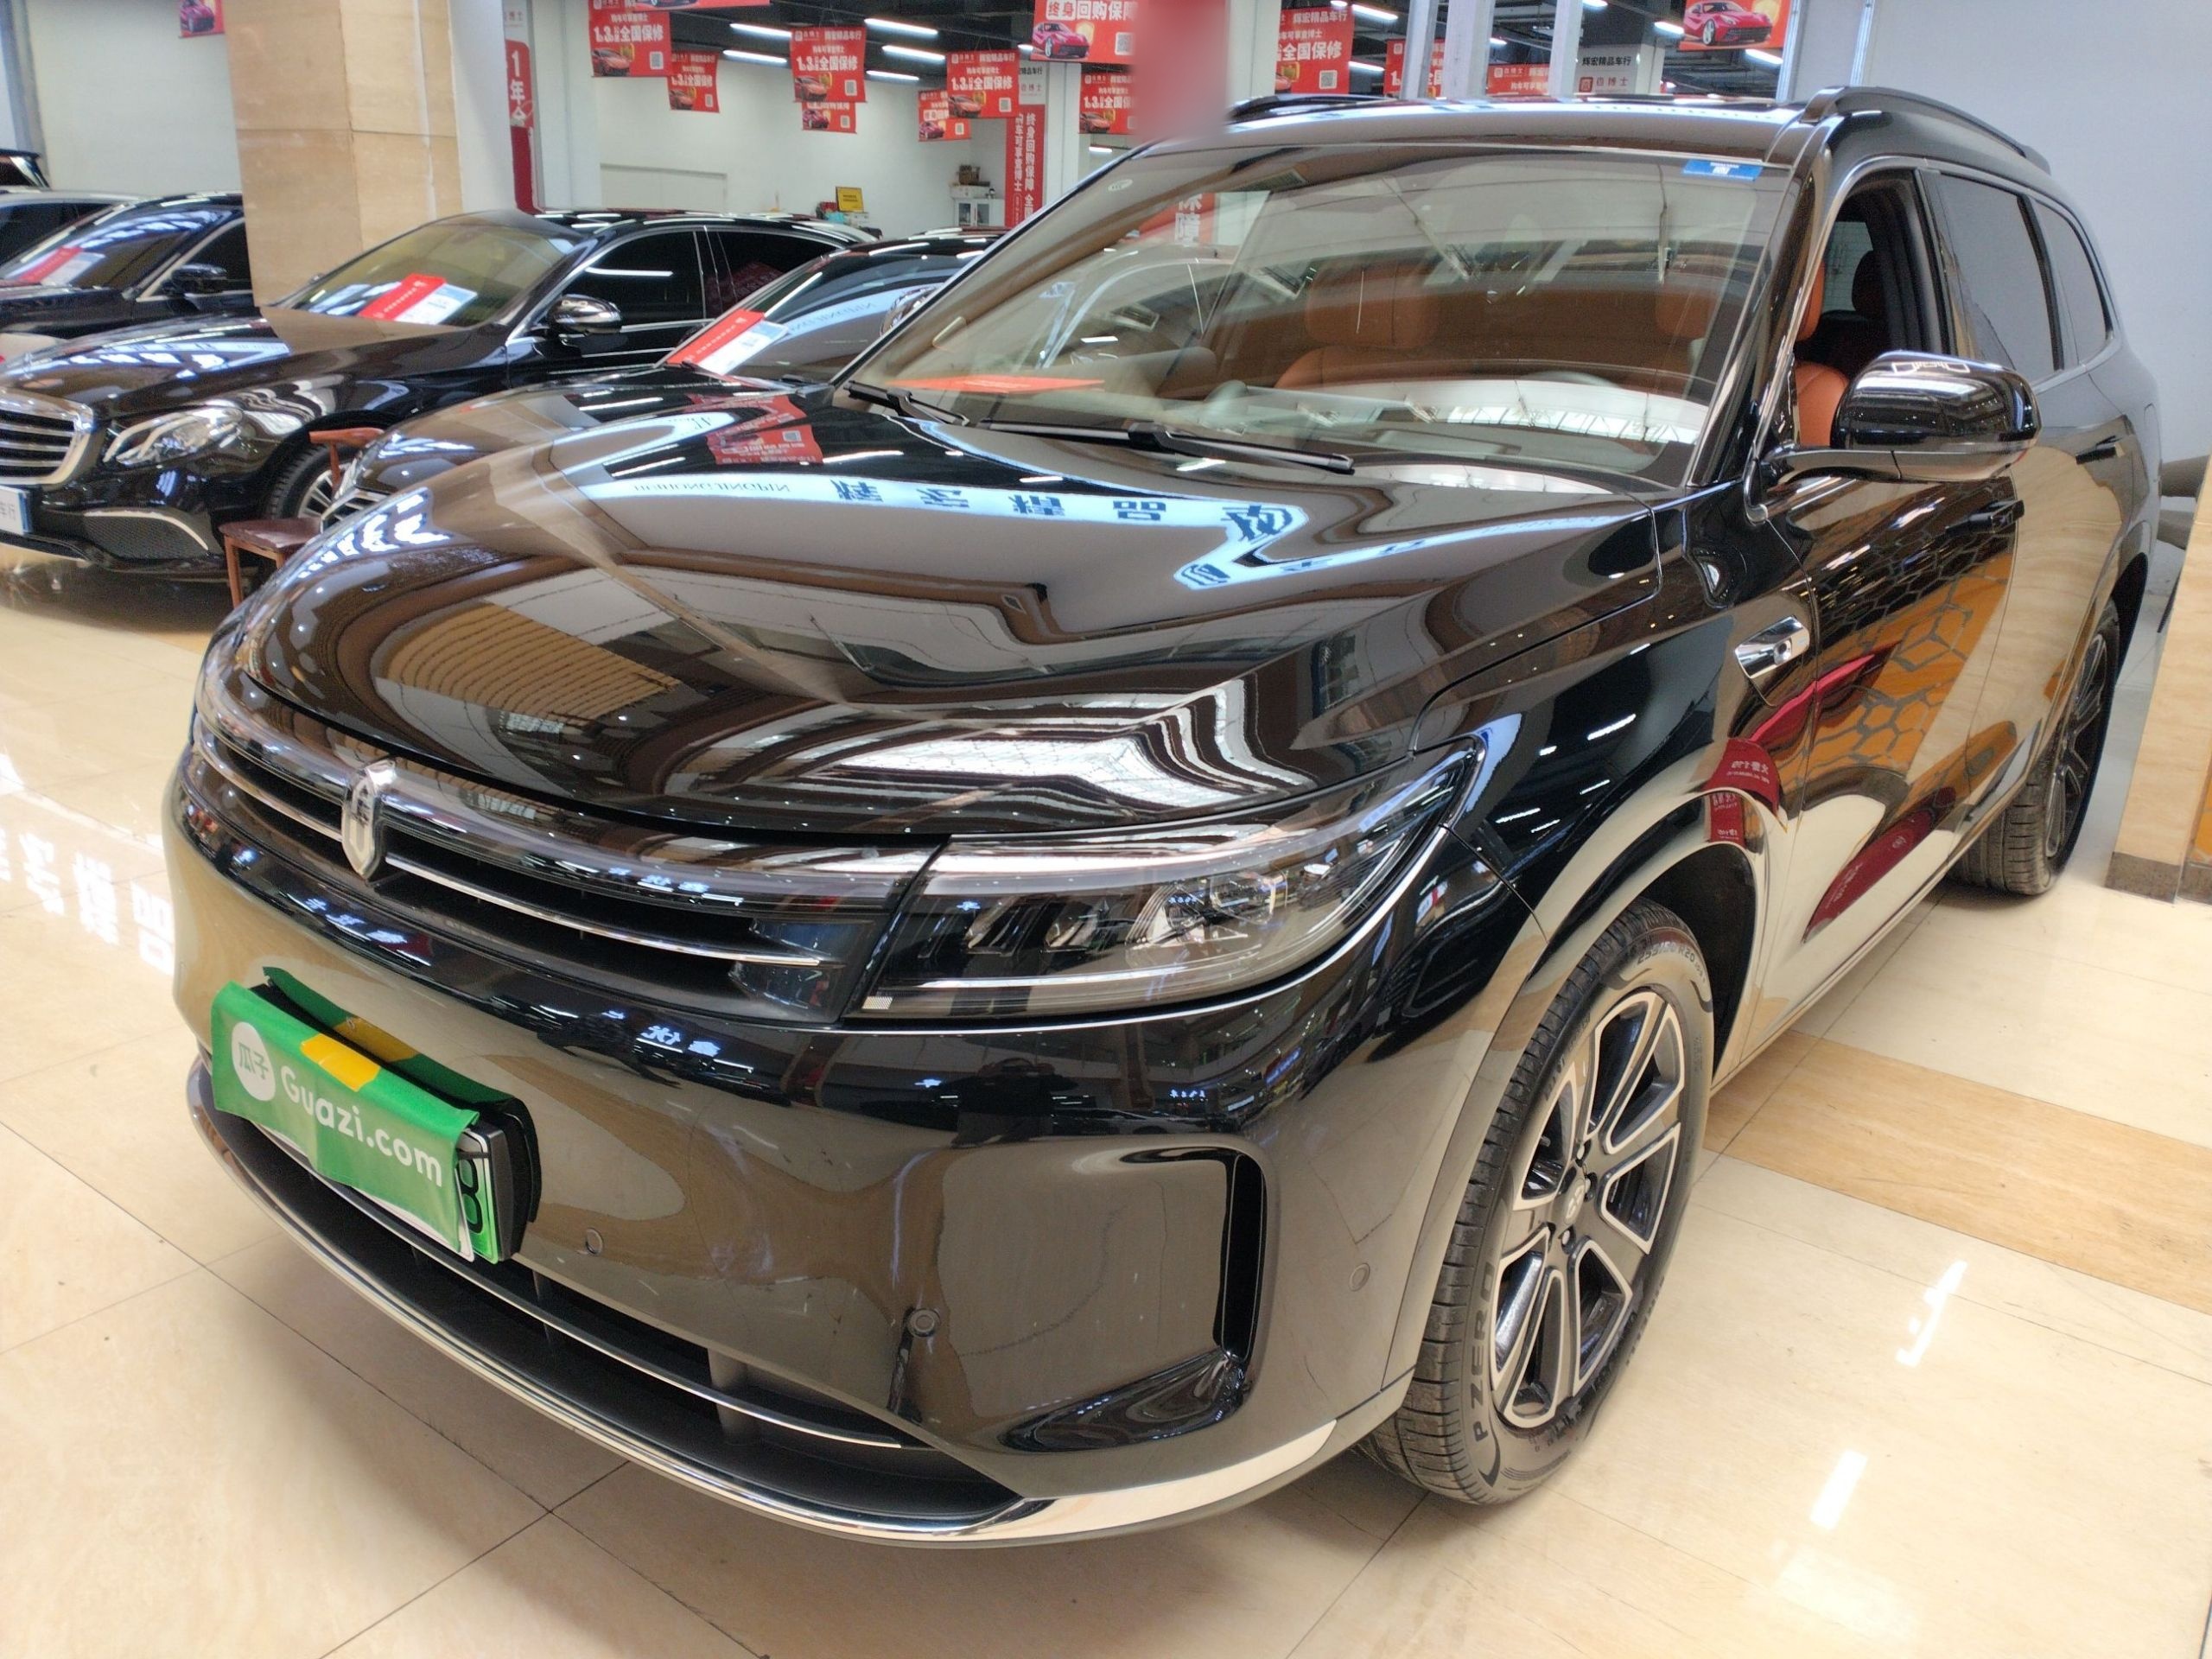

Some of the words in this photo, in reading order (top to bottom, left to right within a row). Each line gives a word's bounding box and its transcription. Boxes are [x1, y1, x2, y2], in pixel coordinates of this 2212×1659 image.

[1582, 56, 1632, 67] 辉宏精品车行
[238, 1041, 270, 1081] 瓜子
[280, 1065, 442, 1188] Guazi.com
